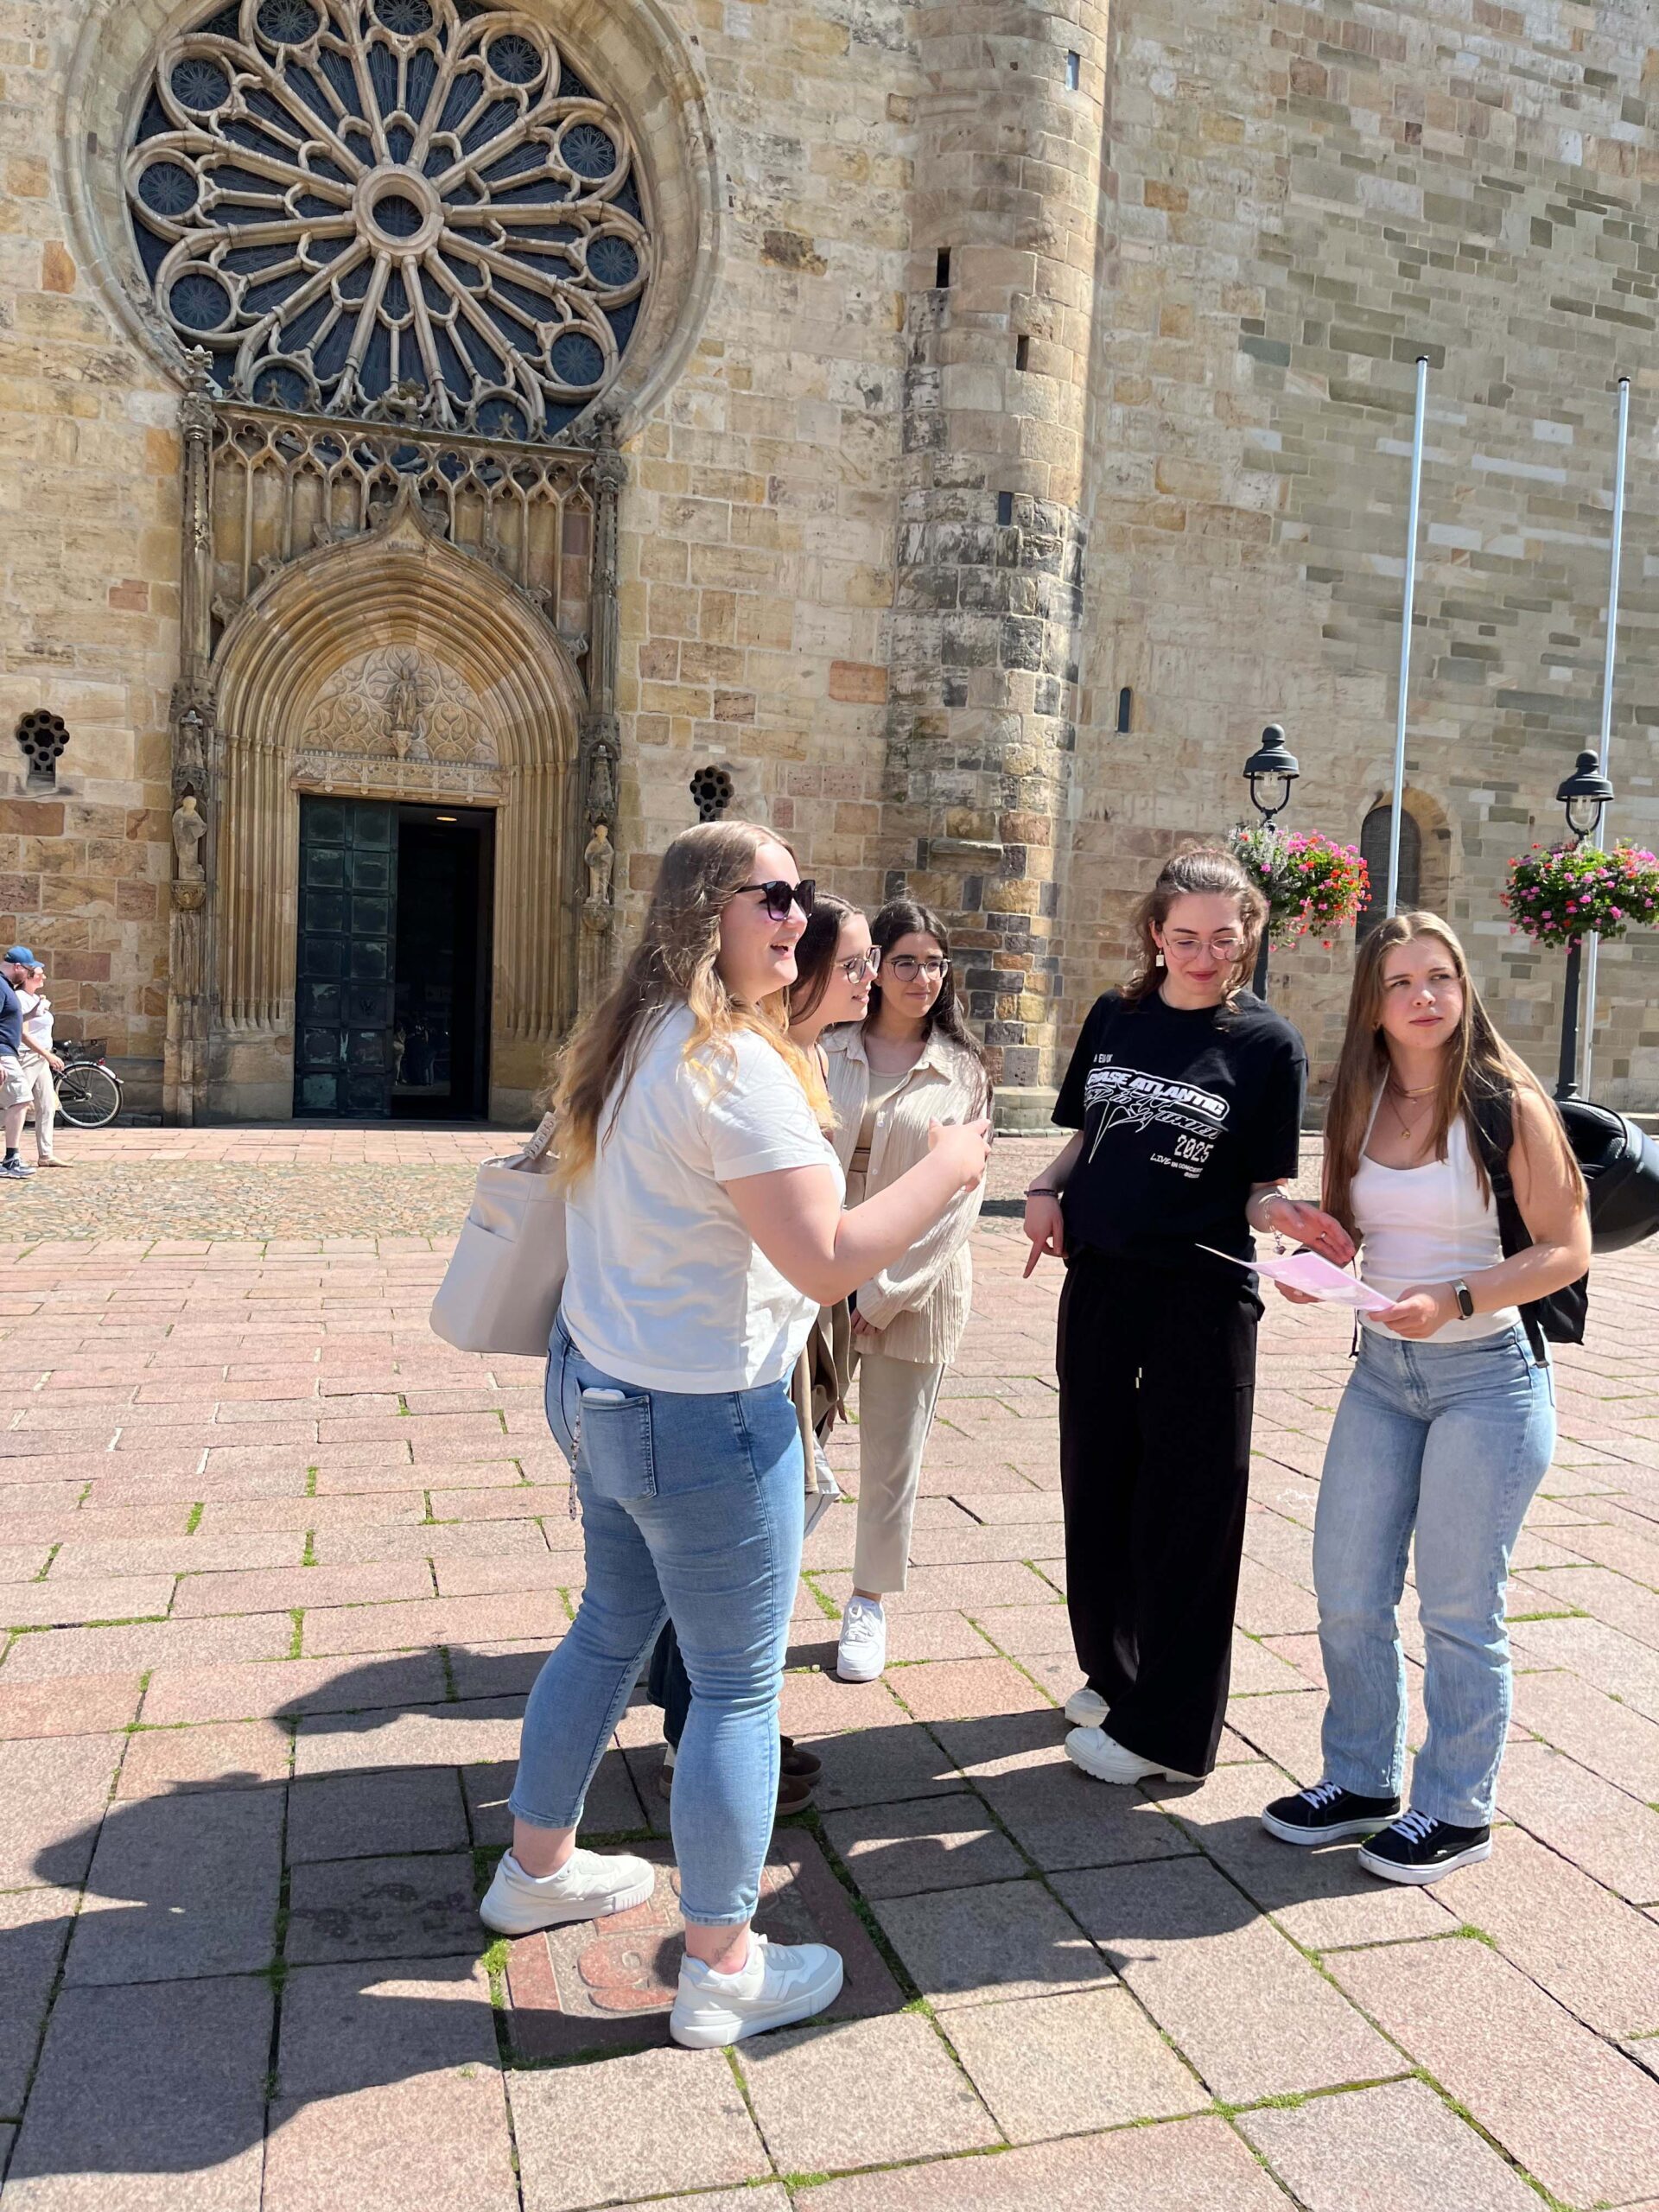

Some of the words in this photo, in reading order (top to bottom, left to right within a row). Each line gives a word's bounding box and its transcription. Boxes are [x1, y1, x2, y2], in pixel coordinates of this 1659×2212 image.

[1128, 1077, 1225, 1116] ATLANTIC
[1150, 1153, 1172, 1165] LIVE
[1178, 1163, 1204, 1173] CONCERT
[1174, 1134, 1214, 1163] 2025
